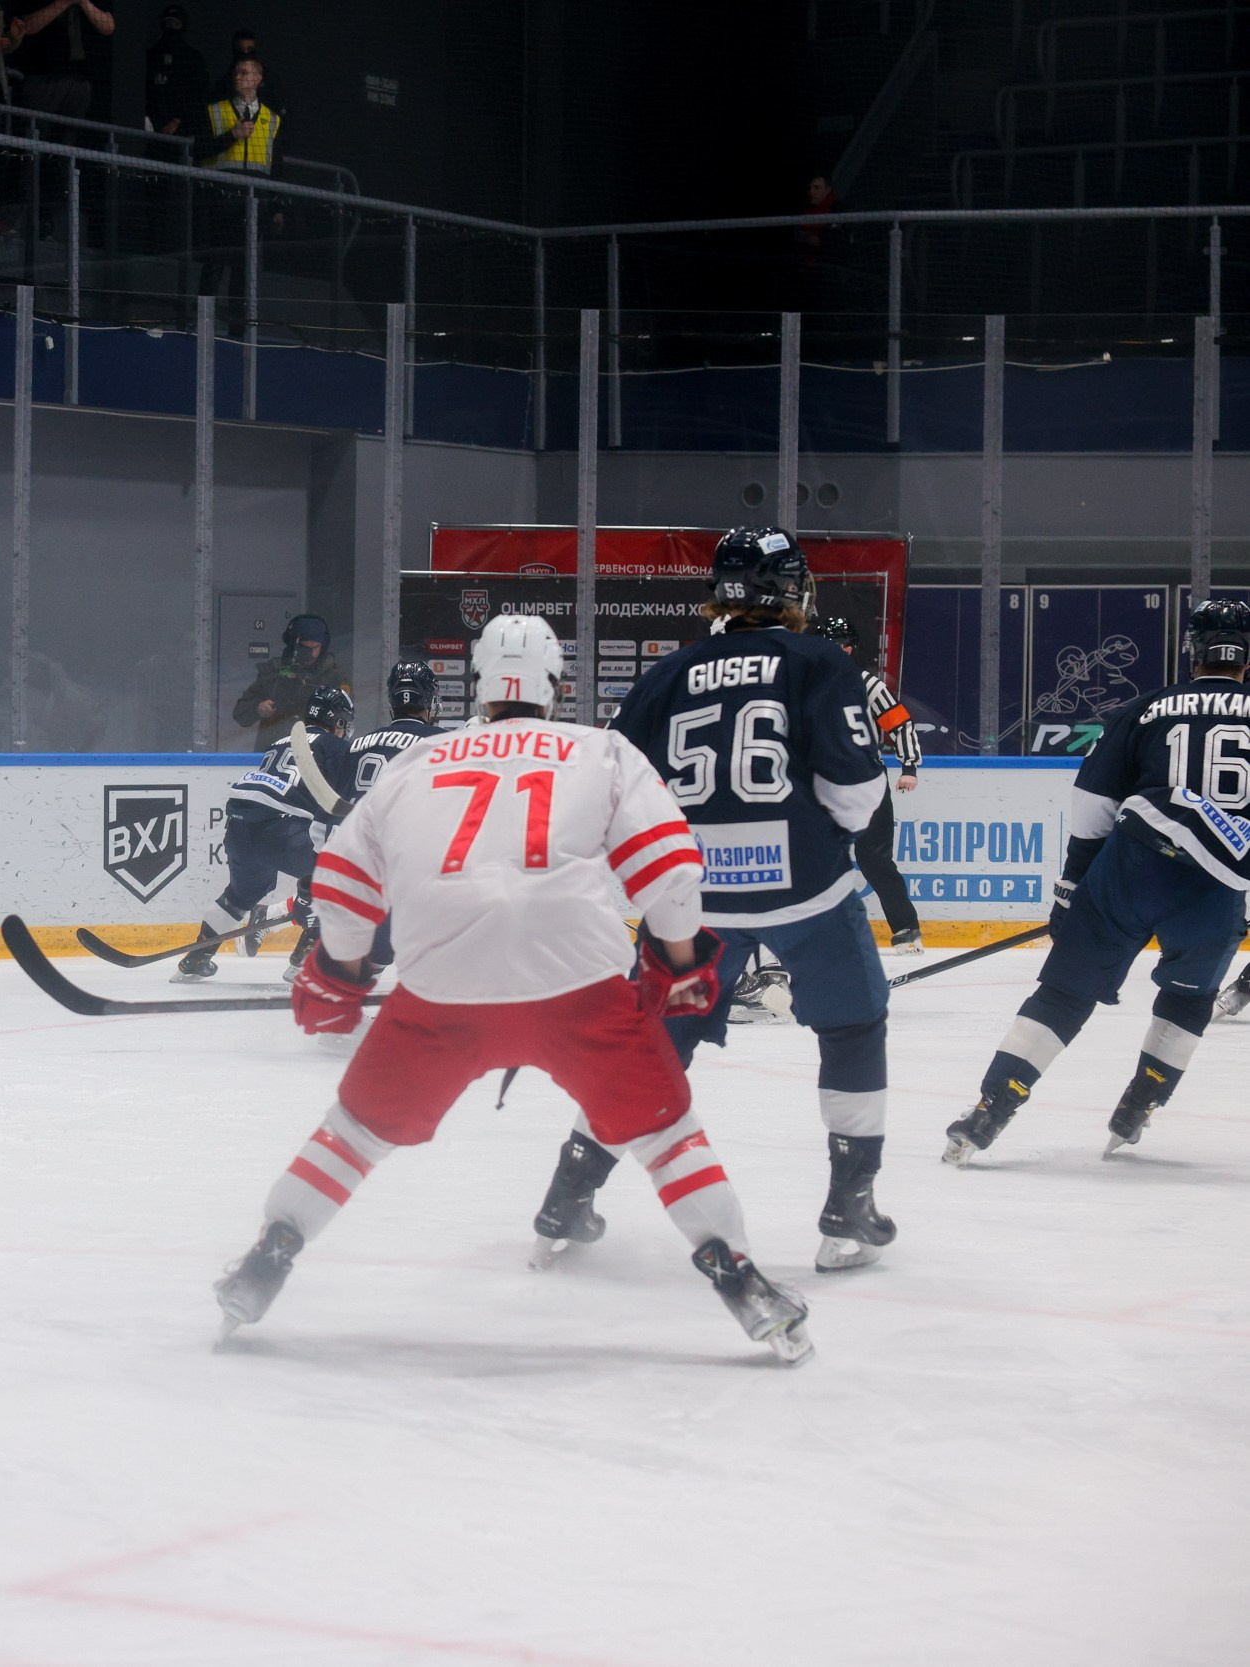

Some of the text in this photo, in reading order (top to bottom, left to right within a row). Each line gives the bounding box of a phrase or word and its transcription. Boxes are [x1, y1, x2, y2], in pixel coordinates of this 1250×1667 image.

[595, 564, 655, 575] ЕРВЕНСТВО
[724, 582, 746, 599] 56
[1144, 593, 1160, 609] 10
[501, 602, 573, 616] OLIMPBET
[575, 603, 684, 617] ОЛОДЕЖНАЯ
[1009, 594, 1020, 609] 8
[1039, 594, 1050, 609] 9
[1220, 646, 1236, 661] 16
[688, 656, 781, 695] GUSEV
[403, 691, 411, 704] 9
[502, 677, 521, 700] 71
[429, 731, 575, 764] SUSUYEV
[667, 700, 794, 805] 56
[1166, 723, 1250, 809] 16
[432, 770, 555, 874] 71
[1204, 801, 1246, 853] ЭКСПОРТ
[109, 810, 183, 865] ВХЛ
[893, 821, 1044, 864] АЗПРОМ
[707, 845, 782, 867] ГАЗПРОМ
[711, 871, 782, 884] ЭКСПОРТ
[909, 878, 1037, 898] КСПОРТ
